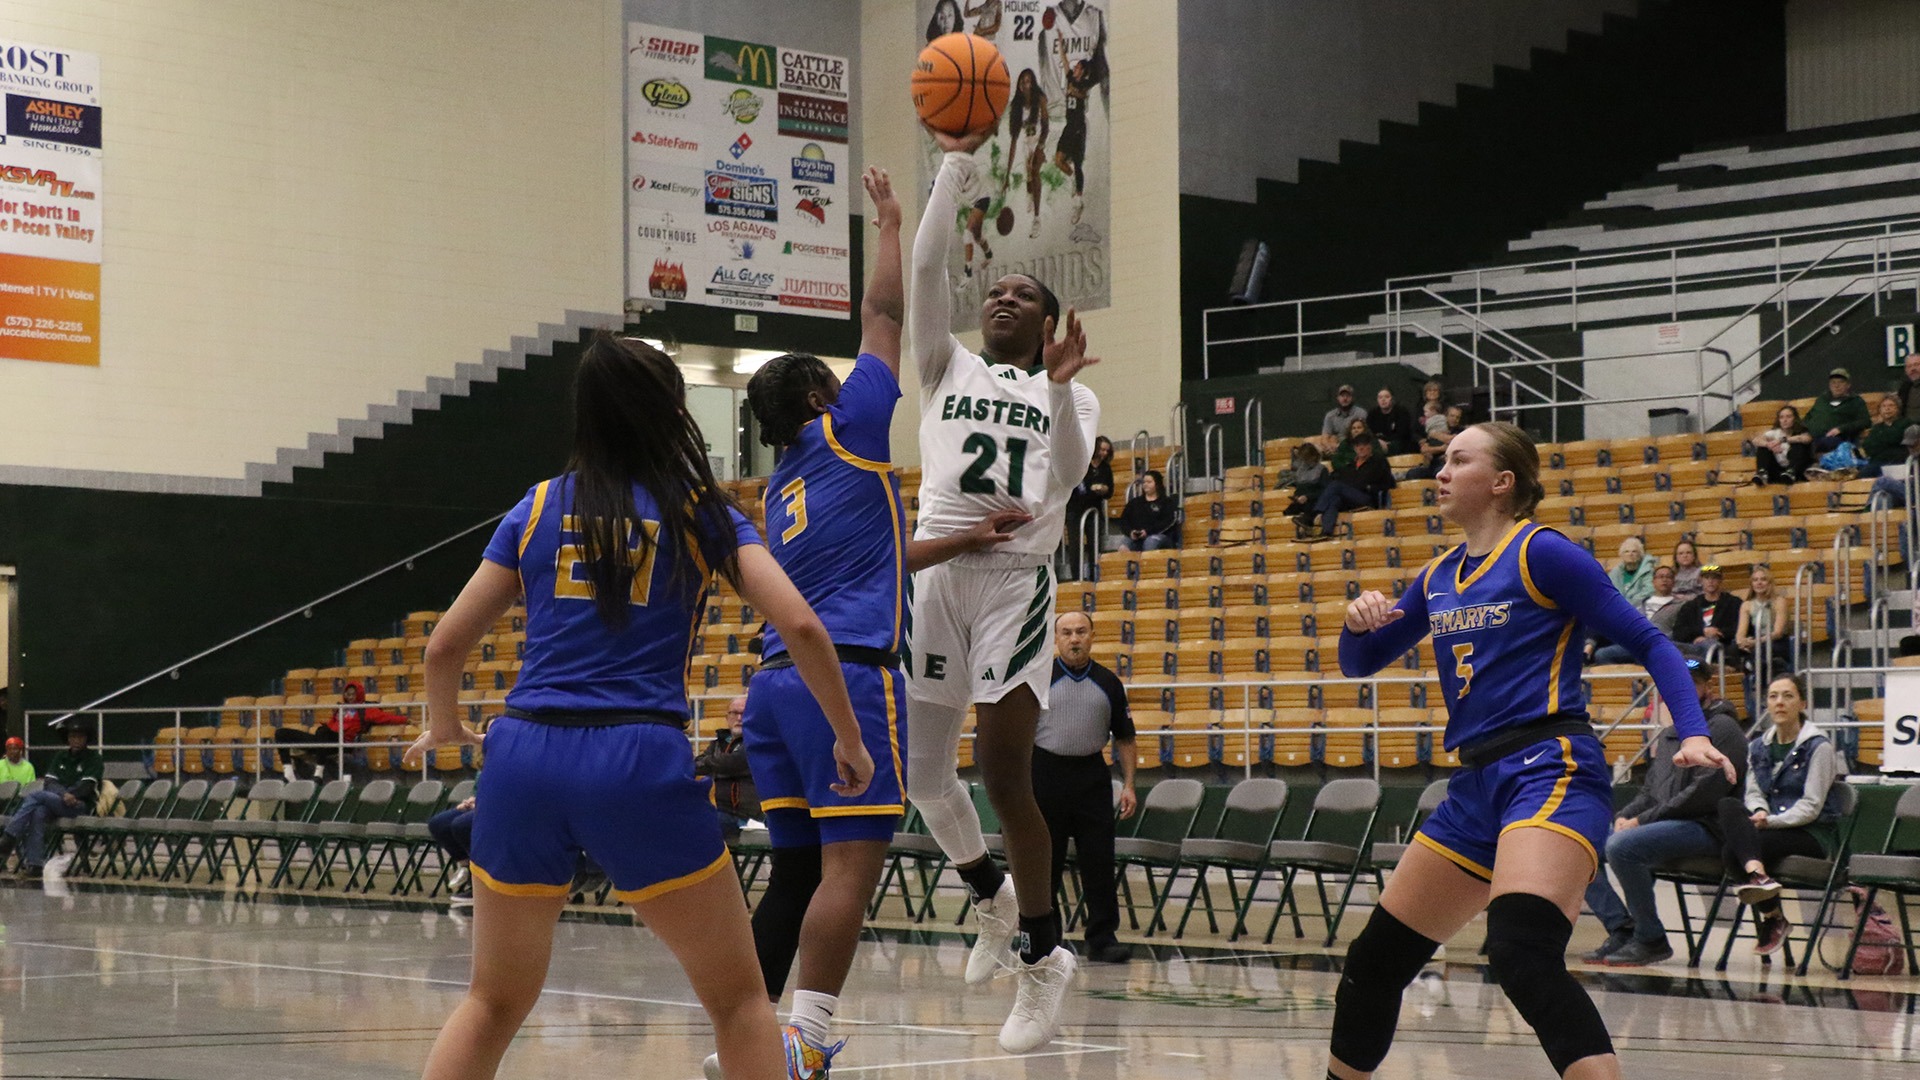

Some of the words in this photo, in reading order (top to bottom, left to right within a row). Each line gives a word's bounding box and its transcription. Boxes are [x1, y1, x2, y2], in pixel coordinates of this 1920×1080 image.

[1013, 15, 1035, 41] 22
[647, 37, 700, 57] snap
[0, 45, 70, 77] OST
[781, 51, 844, 76] CATTLE
[54, 80, 94, 95] GROUP
[784, 67, 842, 91] BARON
[25, 100, 84, 120] ASHLEY
[779, 104, 848, 124] INSURANCE
[25, 113, 84, 129] FURNITURE
[22, 139, 62, 152] SINCE
[64, 145, 92, 157] 1956
[715, 160, 766, 177] Domino's
[732, 186, 772, 204] SIGNS
[22, 201, 63, 221] Sports
[12, 218, 51, 237] Pecos
[54, 222, 96, 244] Valley
[638, 226, 697, 244] COURTHOUSE
[707, 220, 730, 233] LOS
[732, 221, 777, 240] AGAVES
[43, 286, 58, 297] TV
[66, 289, 95, 301] Voice
[5, 315, 33, 328] (575)
[1894, 327, 1910, 365] B
[959, 432, 1029, 500] 21
[780, 476, 808, 546] 3
[923, 652, 947, 681] E
[1451, 642, 1475, 700] 5
[1892, 714, 1920, 746] S
